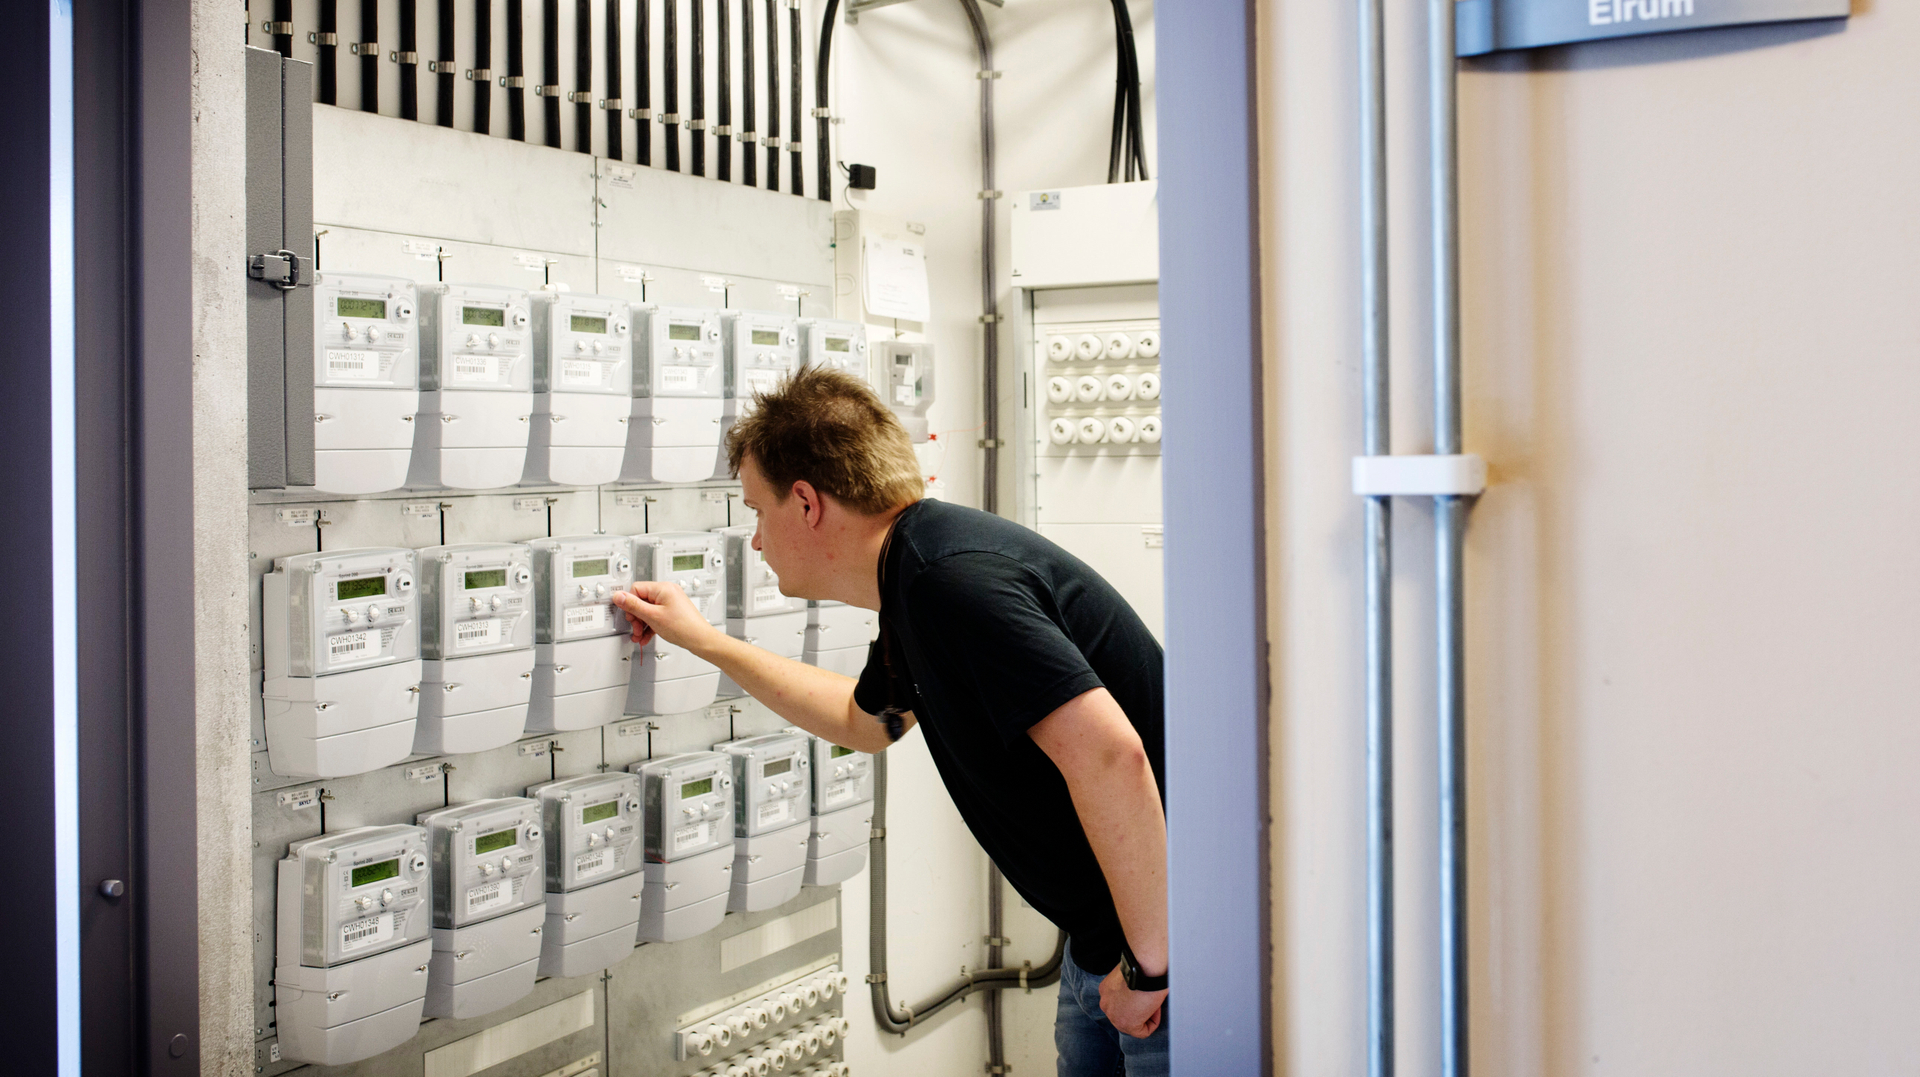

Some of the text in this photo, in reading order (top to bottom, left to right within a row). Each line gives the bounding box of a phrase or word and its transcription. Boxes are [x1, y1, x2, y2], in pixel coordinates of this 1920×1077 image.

[1589, 0, 1694, 25] Elrum
[328, 352, 365, 361] CWH01312
[457, 621, 489, 632] CWH01313
[330, 633, 367, 645] CWH01342
[468, 882, 501, 898] CWH01390
